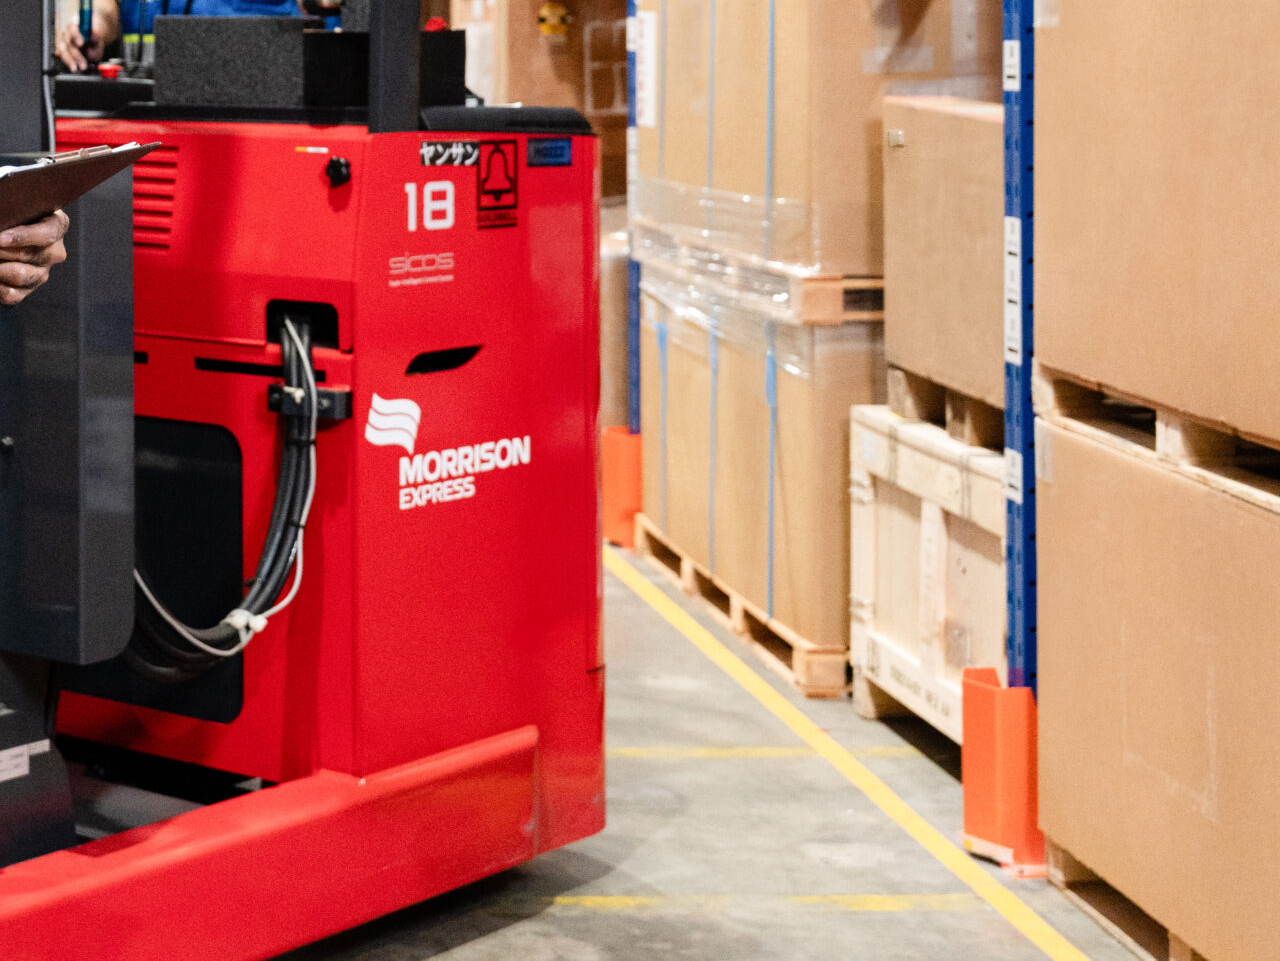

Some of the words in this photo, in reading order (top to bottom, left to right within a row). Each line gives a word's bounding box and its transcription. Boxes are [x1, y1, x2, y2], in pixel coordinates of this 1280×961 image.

[405, 181, 454, 232] 18
[399, 435, 531, 486] MORRISON
[399, 476, 476, 510] EXPRESS
